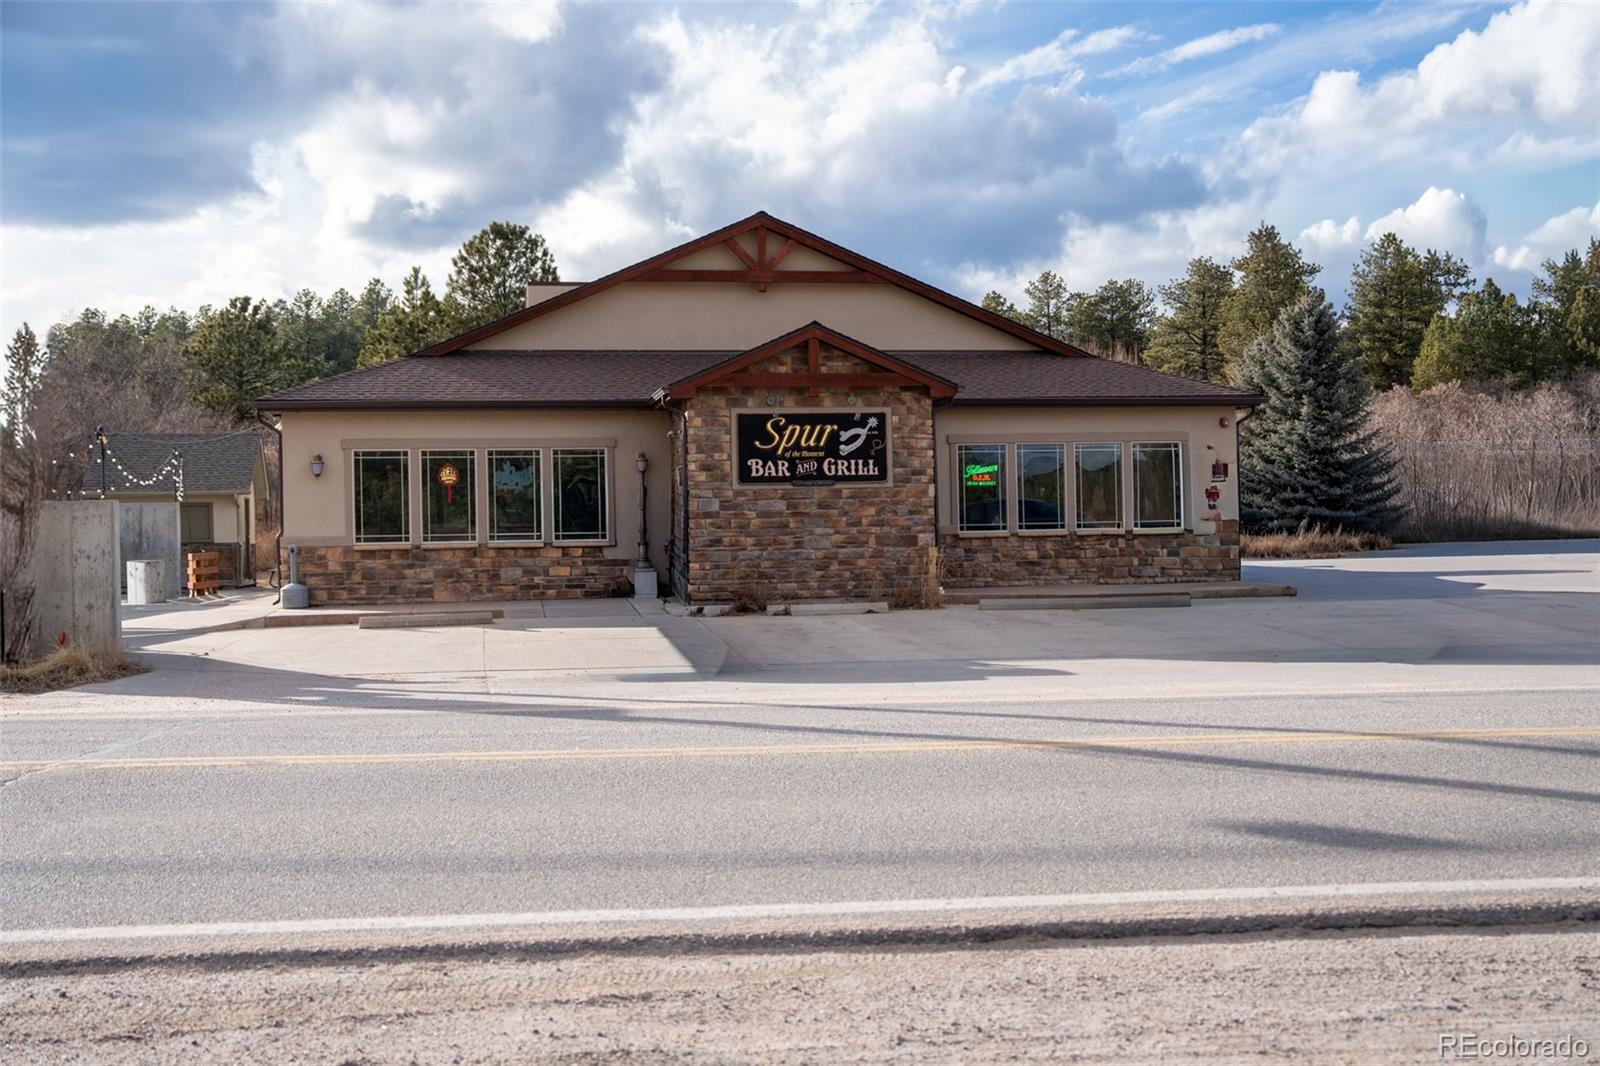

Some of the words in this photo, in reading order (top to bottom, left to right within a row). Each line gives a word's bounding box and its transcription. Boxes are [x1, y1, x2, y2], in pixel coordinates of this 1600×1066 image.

[754, 416, 838, 455] Spur
[747, 458, 791, 477] BAR
[796, 461, 818, 475] AND
[822, 457, 879, 476] GRILL
